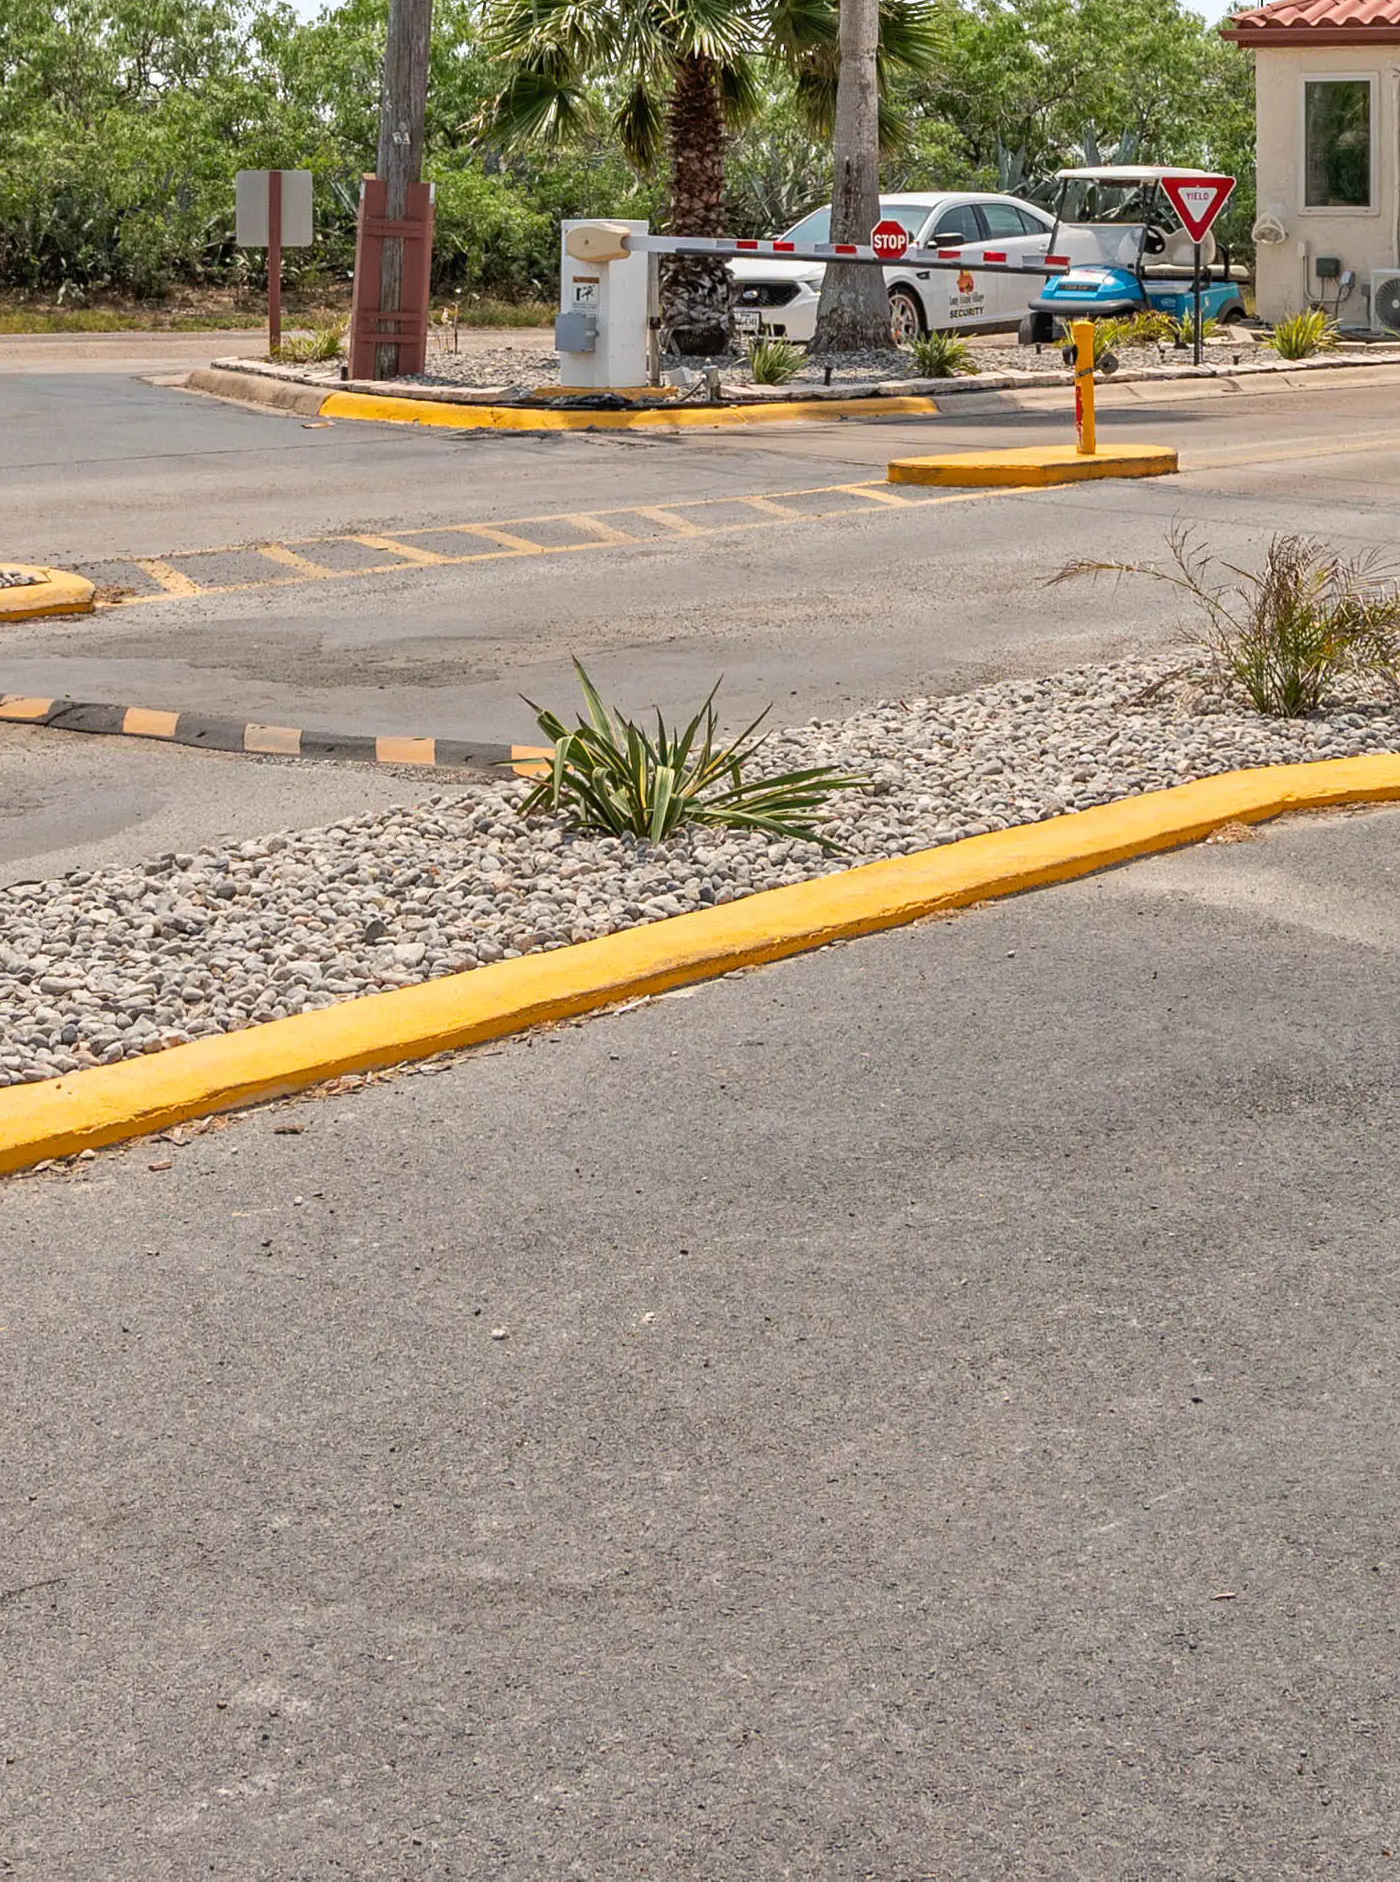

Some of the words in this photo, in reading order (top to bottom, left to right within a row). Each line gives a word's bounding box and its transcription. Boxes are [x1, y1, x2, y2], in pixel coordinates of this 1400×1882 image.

[1186, 192, 1209, 200] YIELD
[874, 234, 906, 249] STOP
[949, 306, 984, 319] SECURITY
